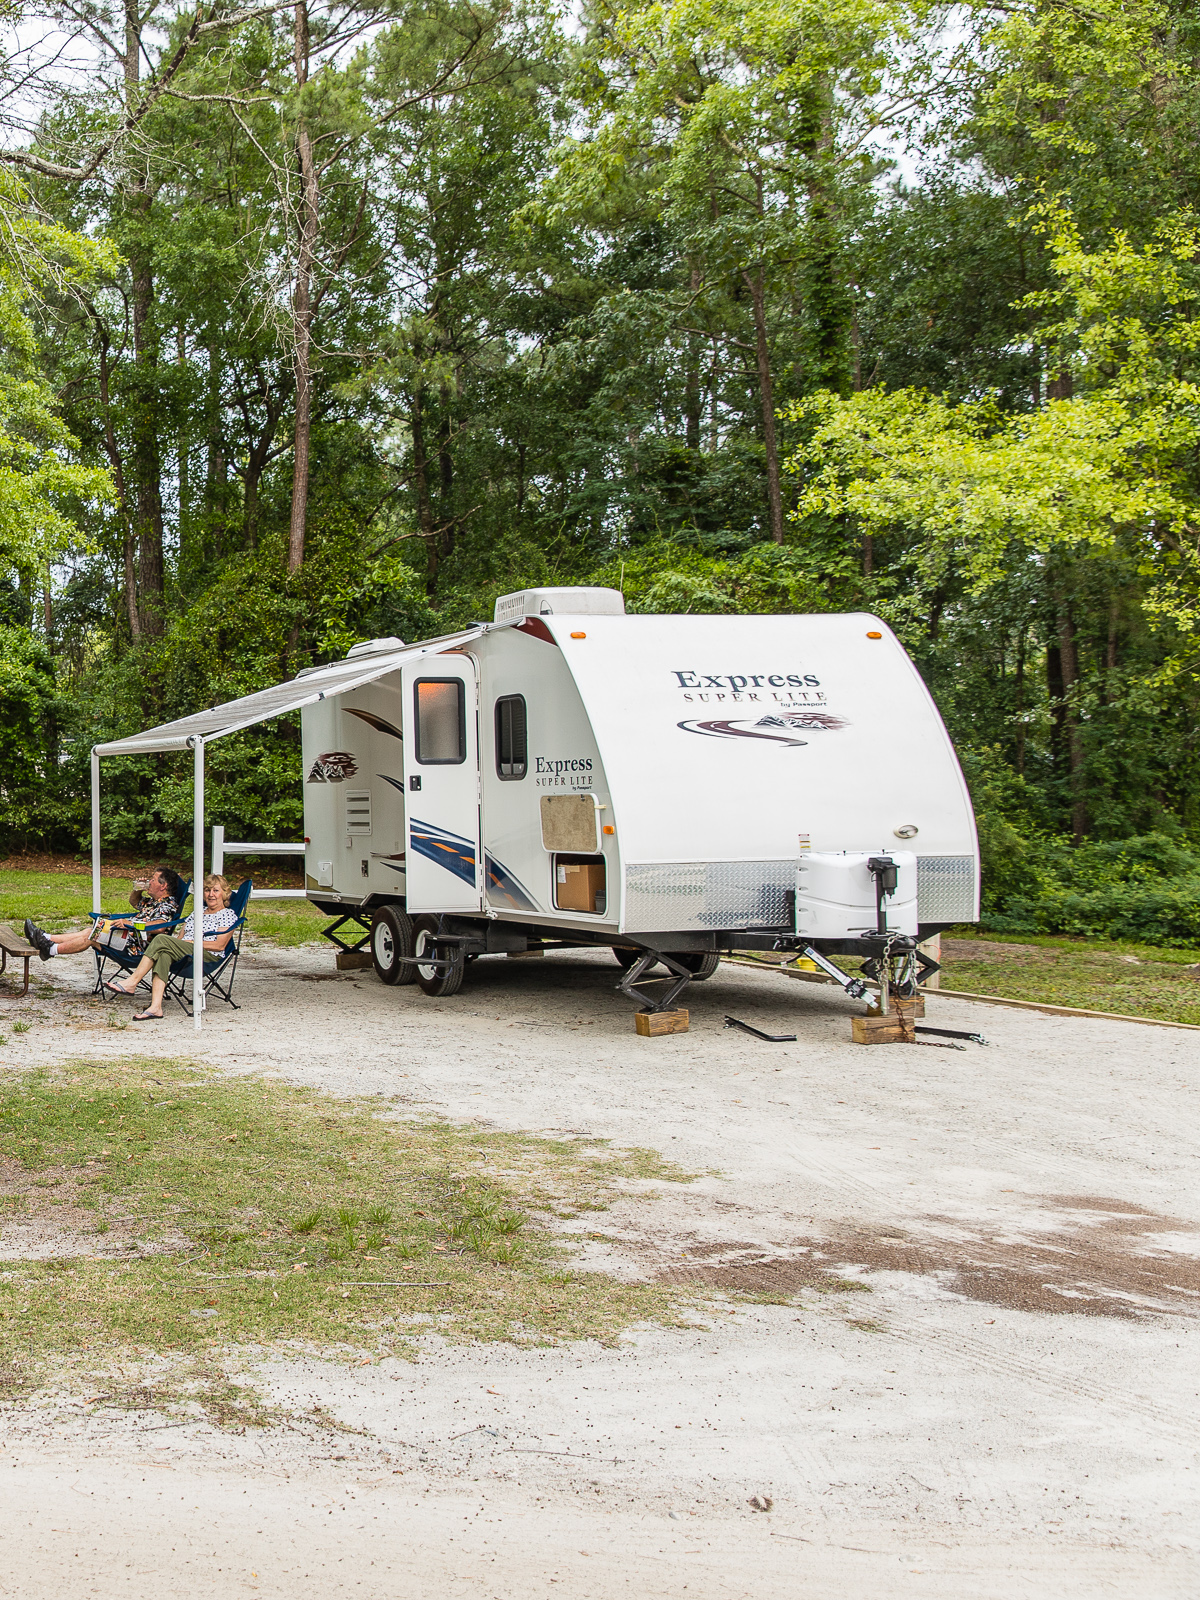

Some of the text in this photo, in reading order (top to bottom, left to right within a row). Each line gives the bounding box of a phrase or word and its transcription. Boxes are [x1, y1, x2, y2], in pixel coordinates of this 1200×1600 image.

[671, 670, 821, 693] Express
[683, 691, 828, 703] SUPER LITE
[535, 756, 593, 777] Express
[536, 776, 593, 787] SUPER LITE
